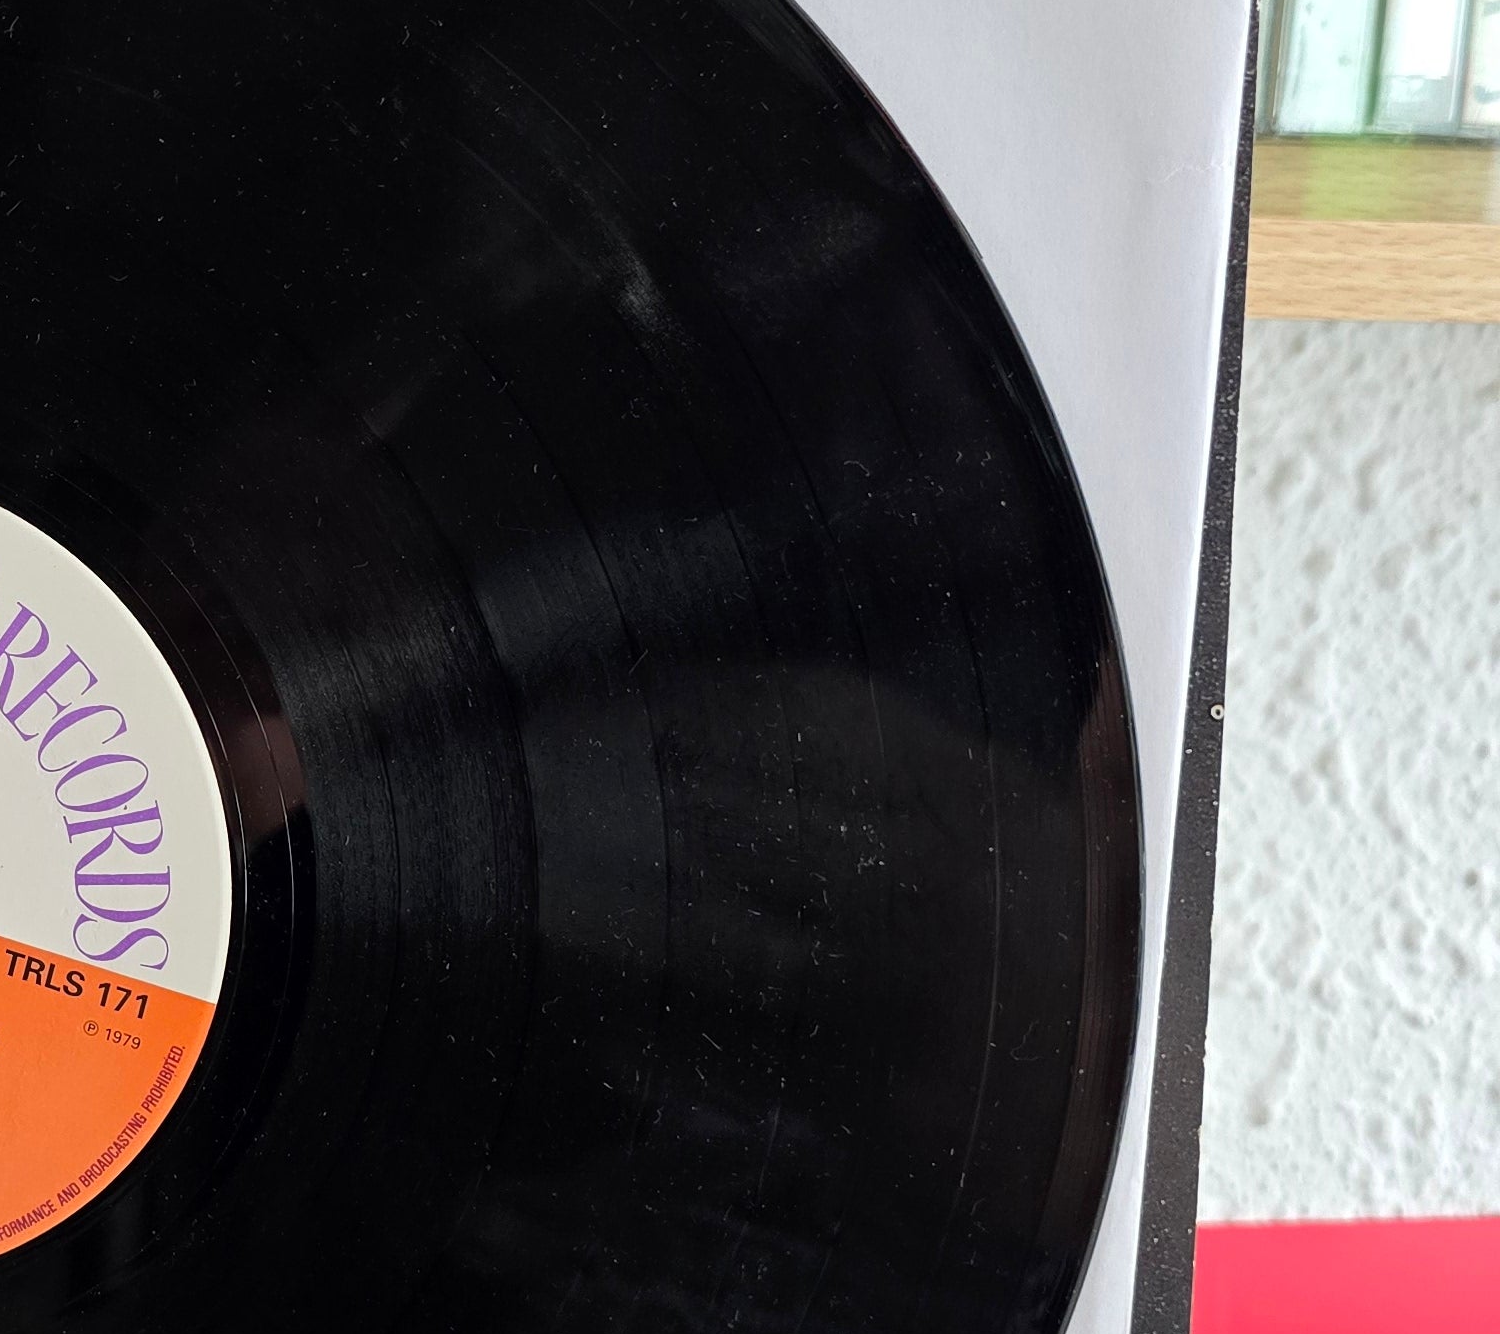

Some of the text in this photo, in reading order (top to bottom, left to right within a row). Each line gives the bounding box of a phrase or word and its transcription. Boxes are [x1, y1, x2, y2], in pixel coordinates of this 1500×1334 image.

[5, 948, 149, 1020] TRLS 171
[105, 1027, 142, 1050] 1979
[56, 1181, 81, 1207] AND
[78, 1112, 147, 1188] BROADCASTING
[141, 1045, 186, 1114] PROHIBITED.
